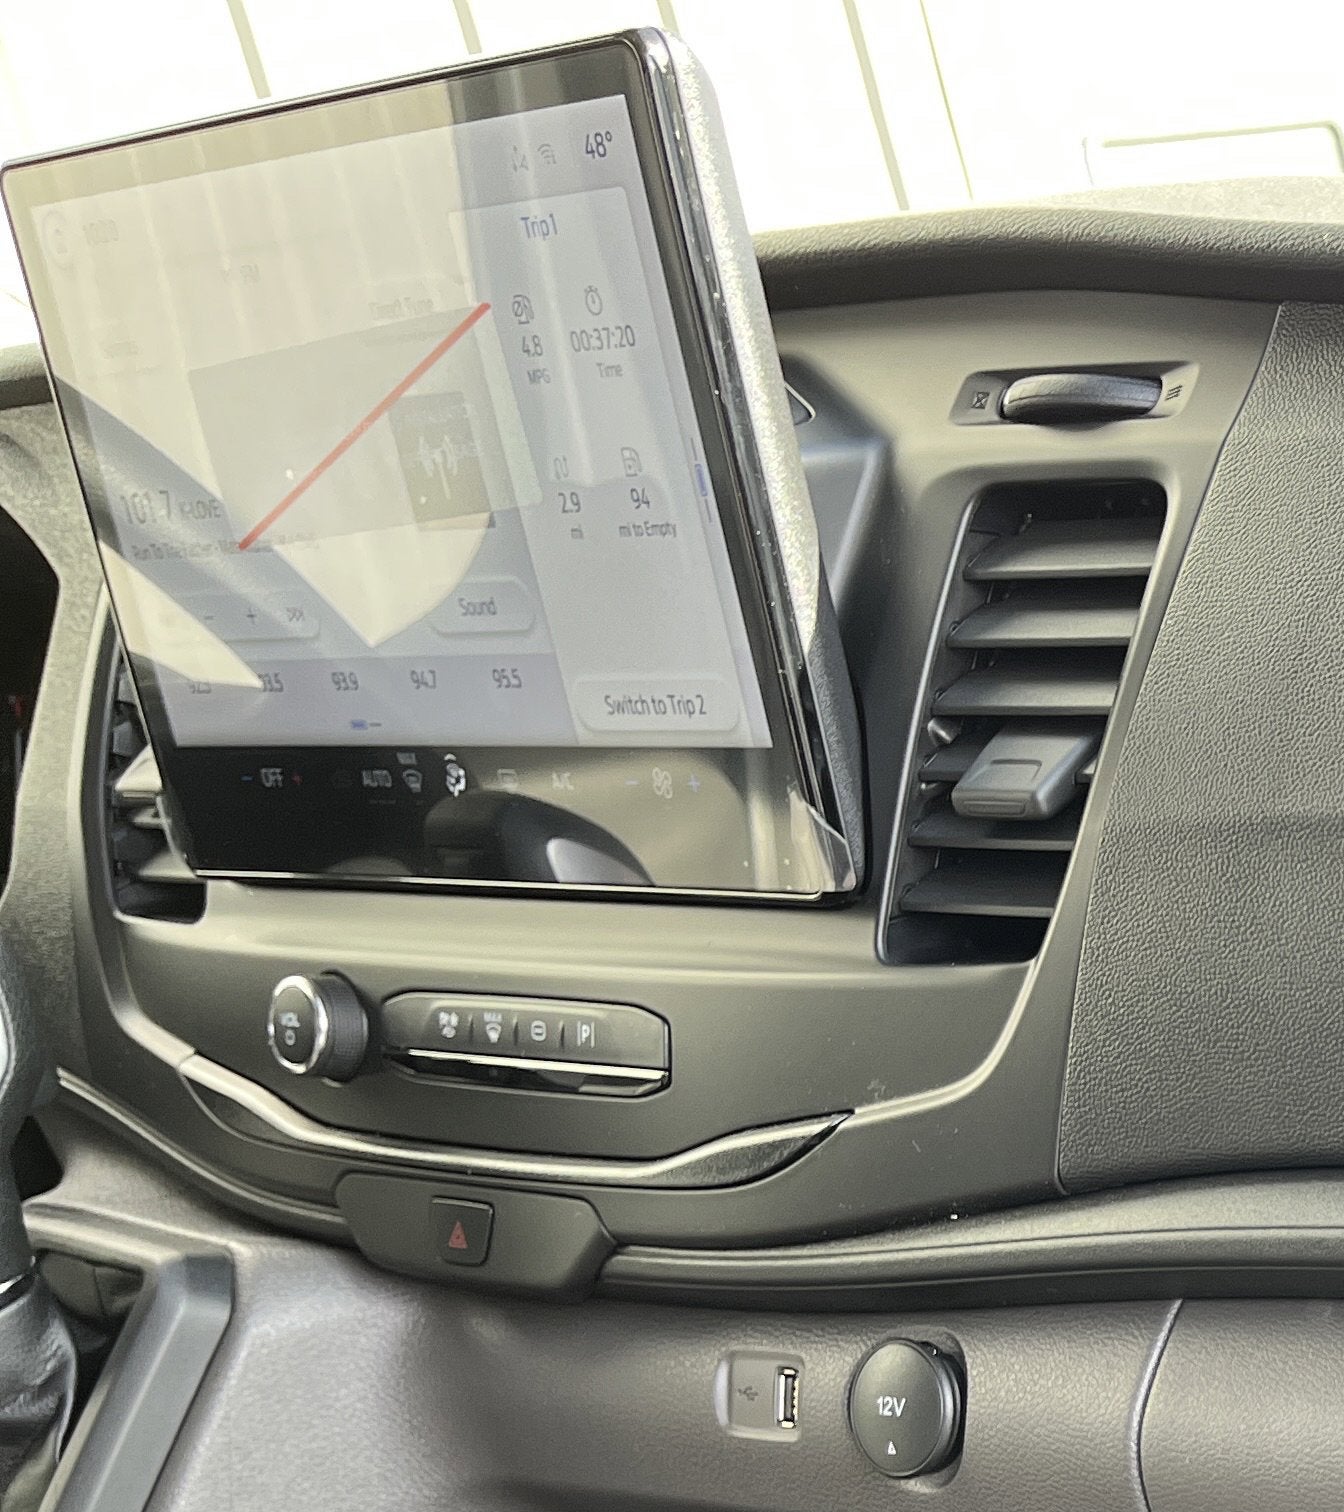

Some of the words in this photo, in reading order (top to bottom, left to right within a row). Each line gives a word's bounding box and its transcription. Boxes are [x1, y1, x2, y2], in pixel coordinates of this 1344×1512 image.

[585, 131, 613, 159] 48°
[521, 334, 544, 357] 4.8
[570, 325, 636, 353] 00:37:20
[527, 368, 552, 386] MPG
[596, 362, 624, 378] Time
[558, 491, 582, 514] 2.9
[630, 488, 650, 510] 94
[571, 524, 584, 540] mi
[618, 523, 631, 538] mi
[643, 521, 677, 539] Empty
[458, 597, 498, 617] Sound
[331, 671, 360, 692] 93.9
[411, 669, 437, 690] 94.7
[492, 668, 523, 689] 95.5
[604, 694, 650, 716] Switch
[650, 697, 667, 716] to
[667, 694, 695, 719] Trip
[696, 694, 707, 716] 2
[259, 767, 284, 788] OFF
[361, 769, 393, 788] AUTO
[876, 1395, 907, 1418] 12V
